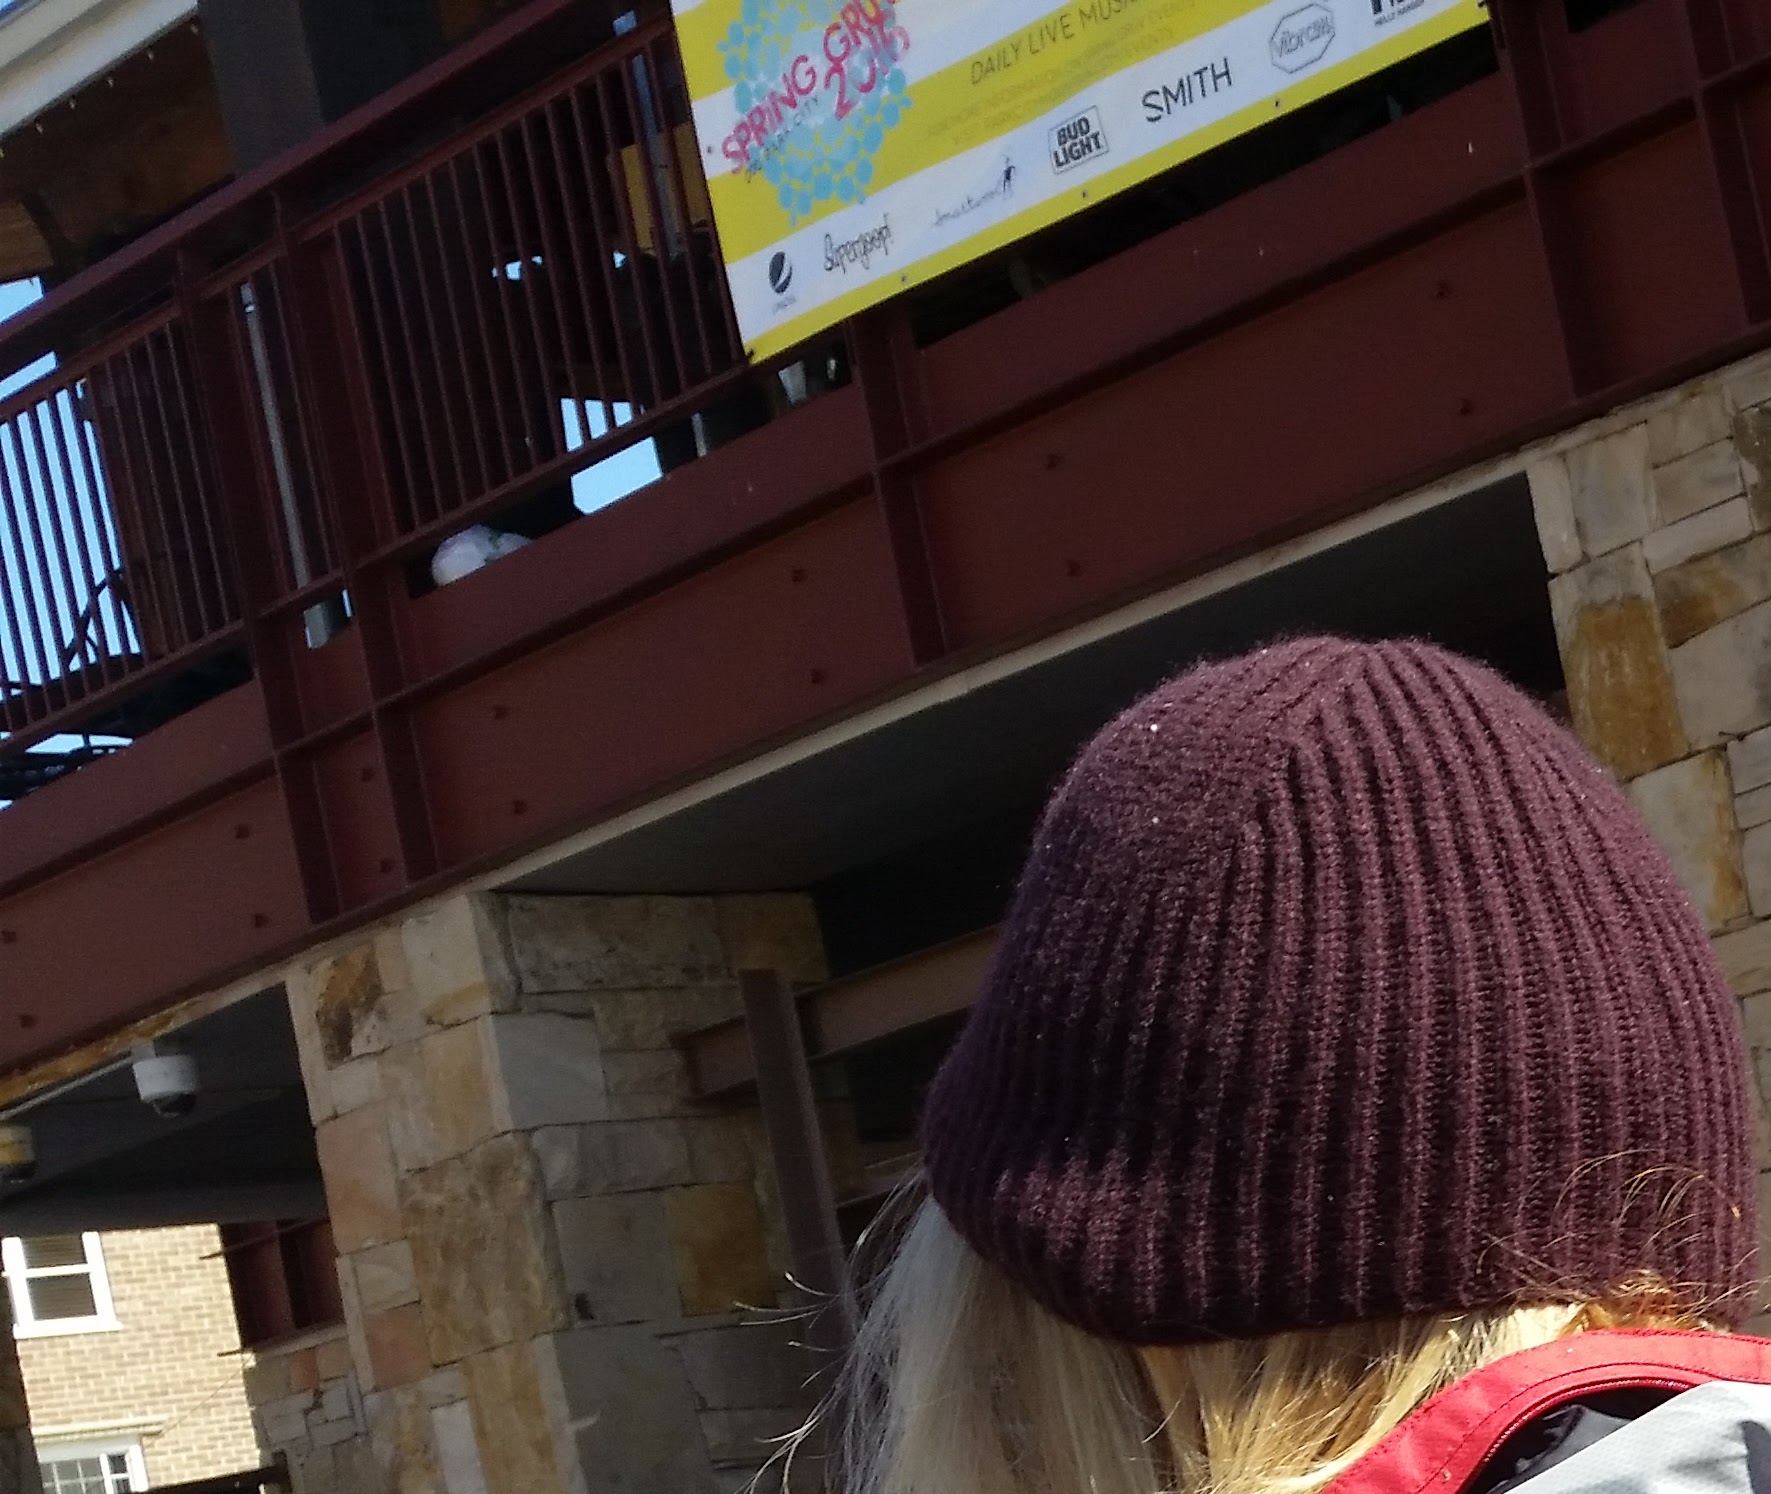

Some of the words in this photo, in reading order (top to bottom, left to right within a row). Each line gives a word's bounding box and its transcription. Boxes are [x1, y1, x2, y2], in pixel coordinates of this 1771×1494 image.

[970, 40, 1024, 85] DAILY
[1028, 14, 1076, 55] LIVE
[1141, 56, 1233, 122] SMITH
[1053, 131, 1104, 168] LIGHT
[1056, 115, 1091, 147] BUD
